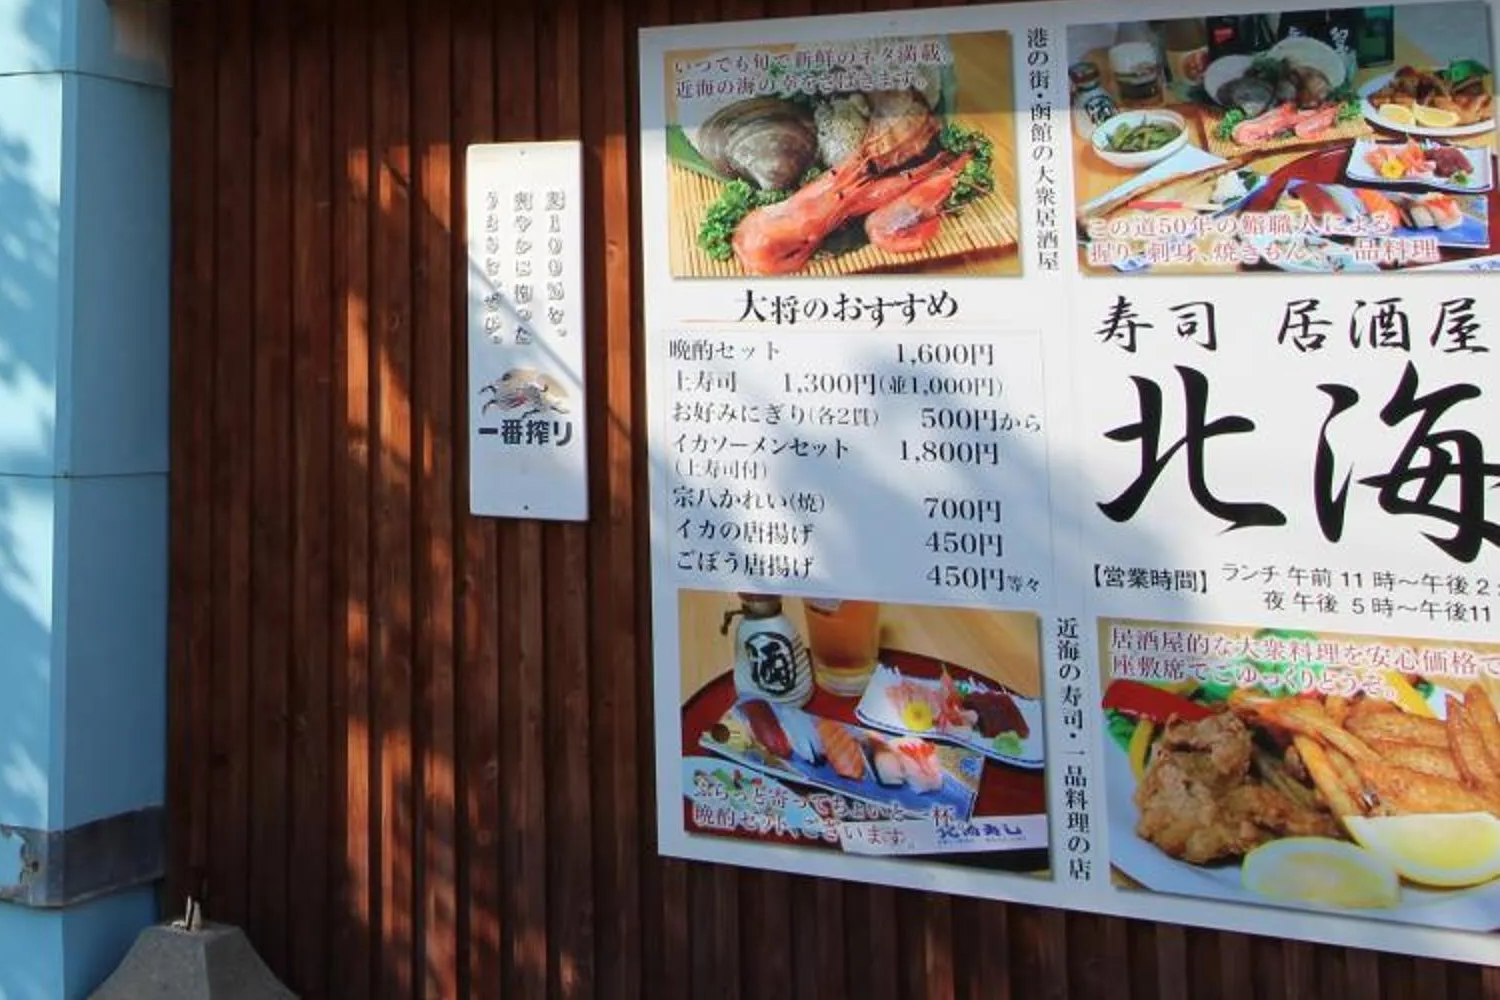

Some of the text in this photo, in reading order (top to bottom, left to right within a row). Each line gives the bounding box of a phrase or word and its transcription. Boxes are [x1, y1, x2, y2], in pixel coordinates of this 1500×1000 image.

[1027, 27, 1060, 272] 港の街・函館の大衆居酒屋
[739, 289, 960, 328] 大将のおすすめ
[1096, 295, 1490, 354] 寿司 居酒屋
[668, 339, 995, 366] 晩酌セット 1,600円
[675, 370, 738, 393] 上寿司
[478, 420, 573, 447] 一番搾り
[921, 407, 1042, 433] 500円から
[671, 435, 1000, 466] イカソーメンセット 1,800円
[1097, 360, 1500, 563] 北海
[924, 497, 1003, 524] 700円
[675, 518, 1004, 558] イカの唐揚げ 450円
[676, 551, 815, 579] ごぼう唐揚げ
[1221, 563, 1280, 584] ランチ
[1264, 590, 1285, 612] 夜
[1056, 616, 1092, 883] 近海の寿司・一品料理の店
